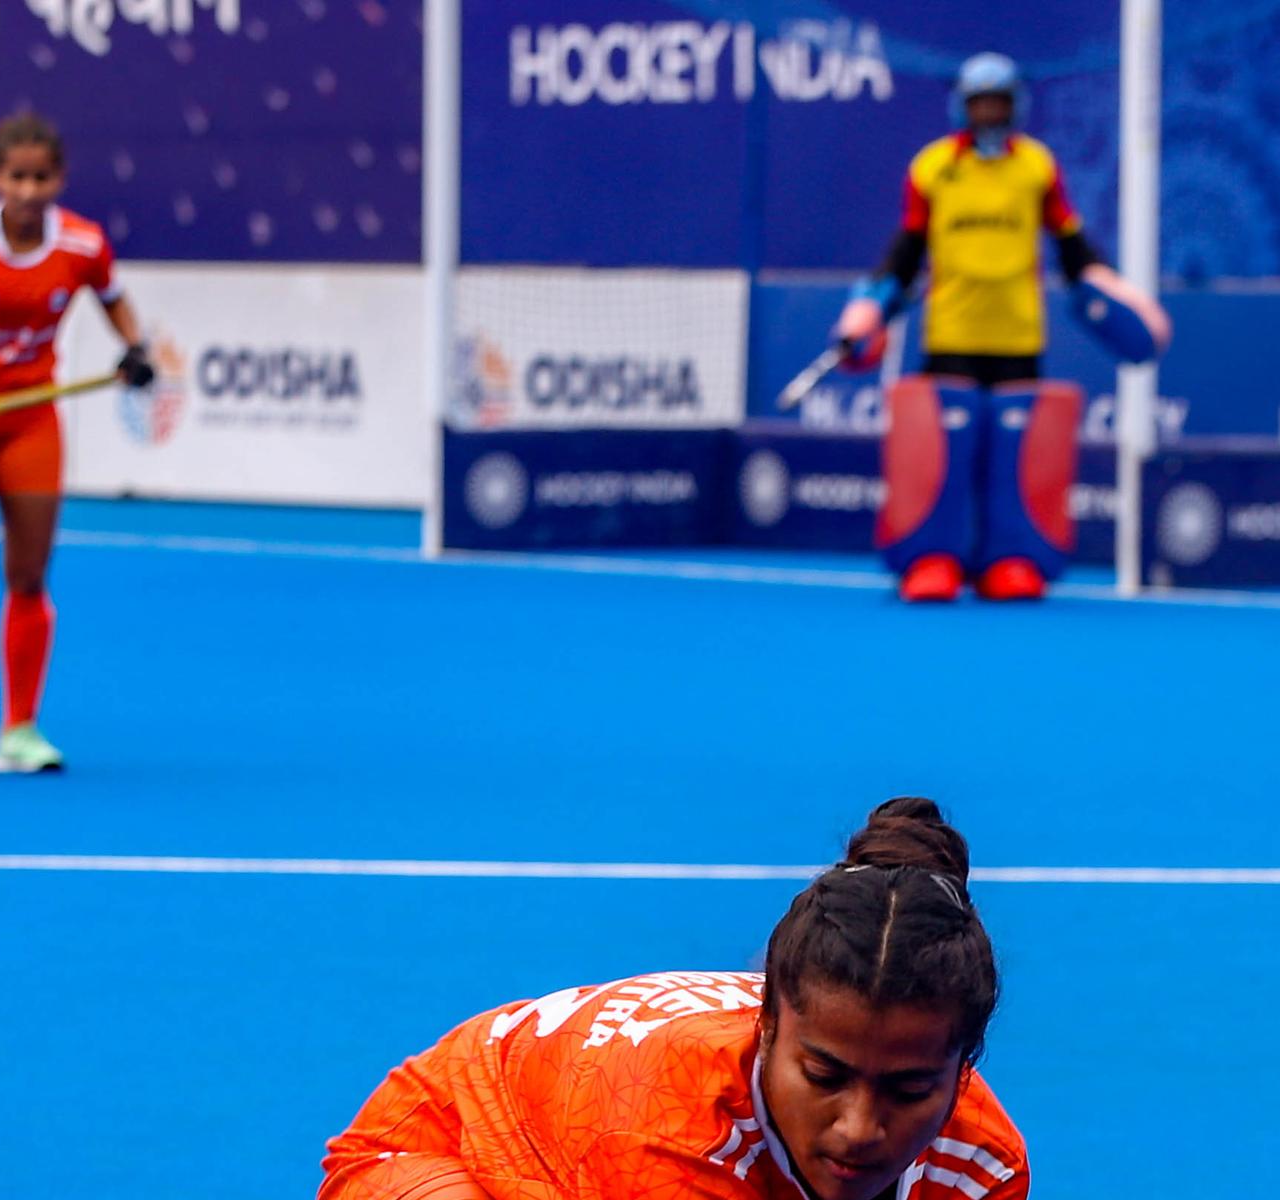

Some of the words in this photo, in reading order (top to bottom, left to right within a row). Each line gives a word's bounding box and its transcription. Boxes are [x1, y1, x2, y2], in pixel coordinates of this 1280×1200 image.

[509, 20, 729, 106] HOCKEY
[732, 18, 893, 101] INDIA
[196, 346, 363, 401] ODISHA
[524, 354, 702, 410] ODISHA
[619, 985, 765, 1047] KEY
